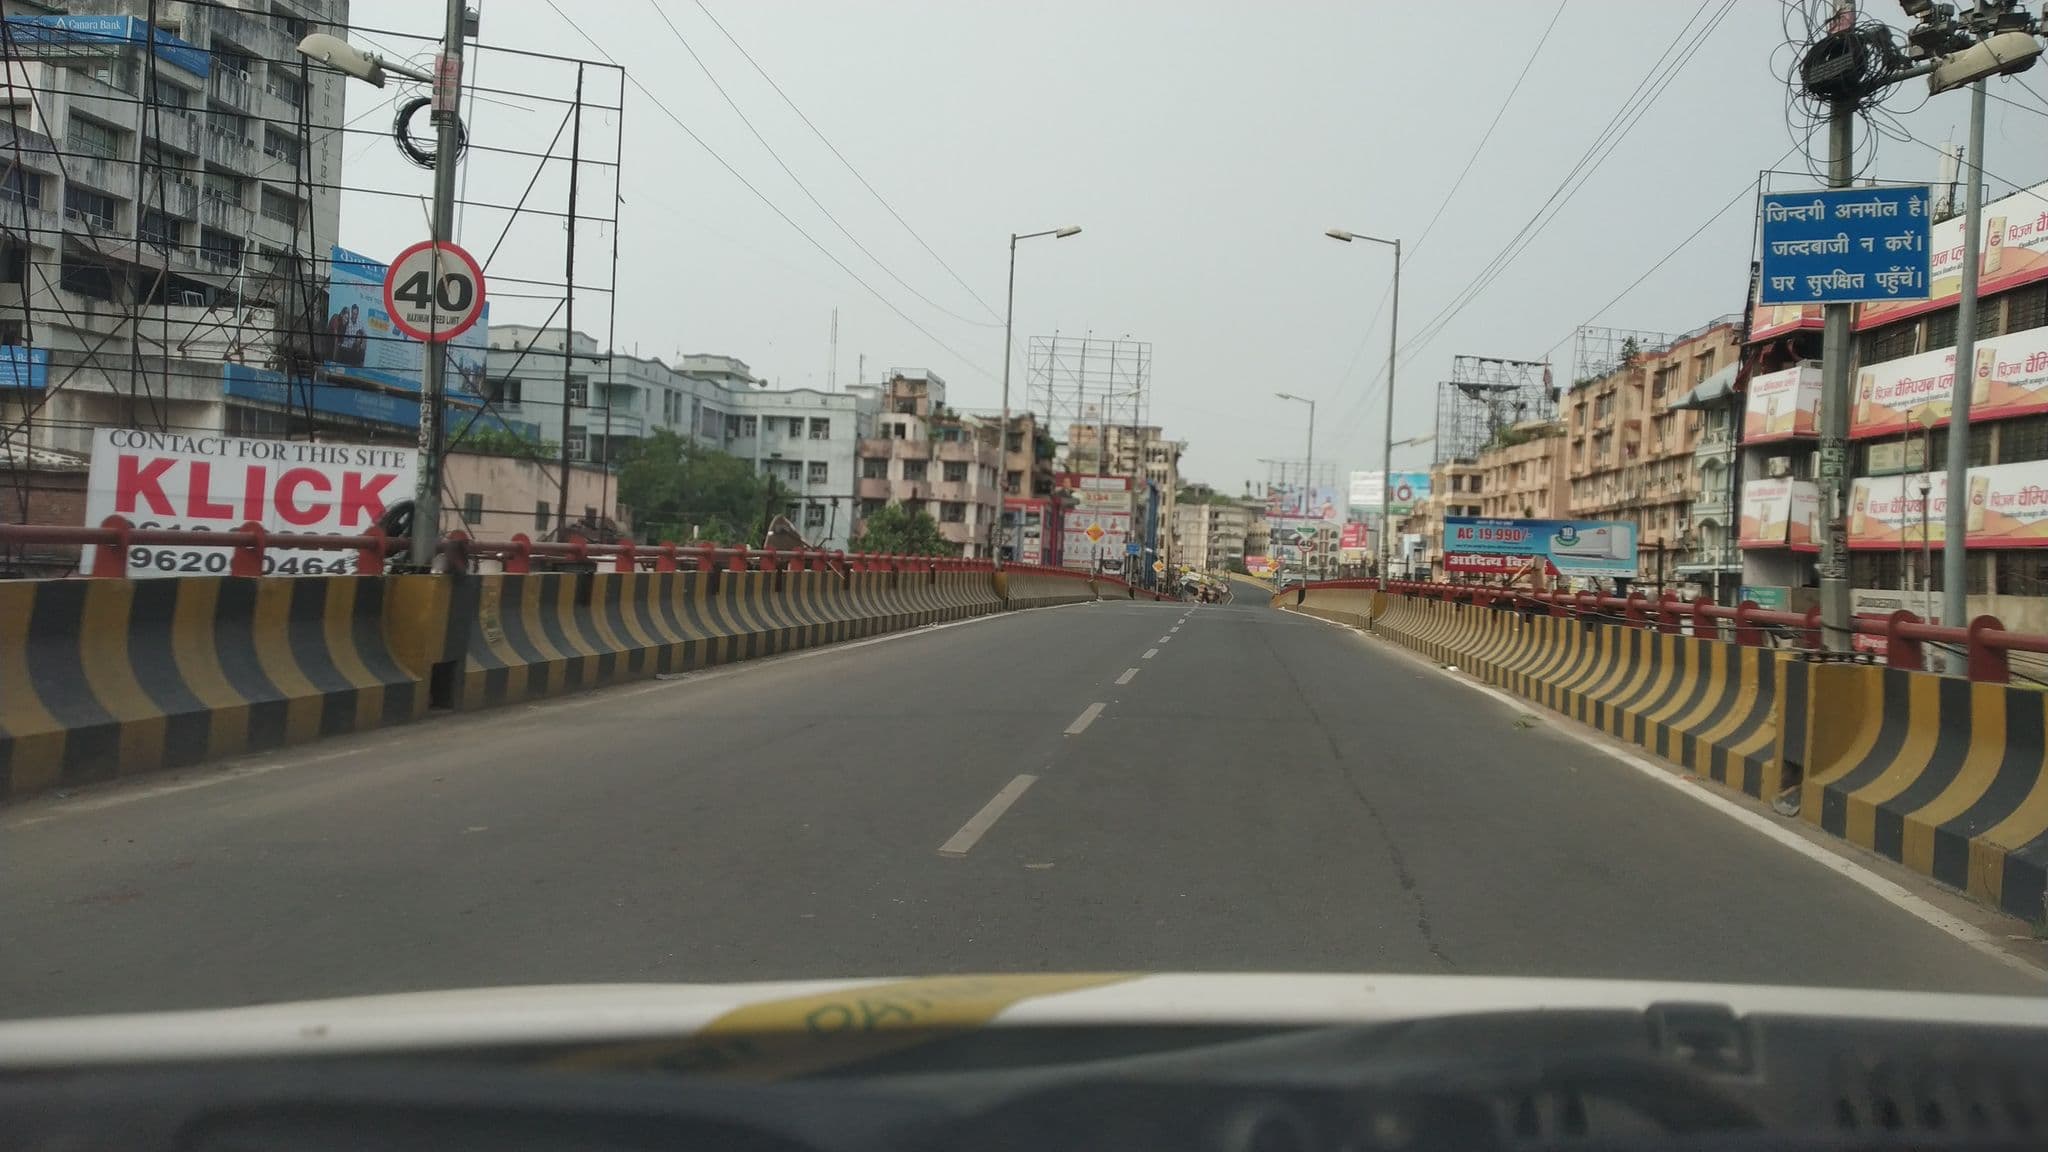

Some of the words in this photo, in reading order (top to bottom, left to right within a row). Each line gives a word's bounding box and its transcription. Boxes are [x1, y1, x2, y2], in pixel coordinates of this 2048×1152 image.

[69, 19, 98, 30] Canara
[99, 19, 121, 30] Bank
[1766, 199, 1825, 223] जिन्दगी
[1835, 197, 1898, 218] अनमोल
[1772, 232, 1849, 256] जल्दबाजी
[1860, 237, 1874, 252] न
[394, 271, 473, 311] 40
[1771, 275, 1796, 291] घर
[1807, 268, 1865, 296] सुरक्षित
[110, 429, 231, 455] CONTACT
[239, 441, 287, 460] FOR
[293, 444, 349, 464] THIS
[356, 449, 406, 469] SITE
[115, 454, 399, 527] KLICK
[1457, 527, 1474, 540] AC
